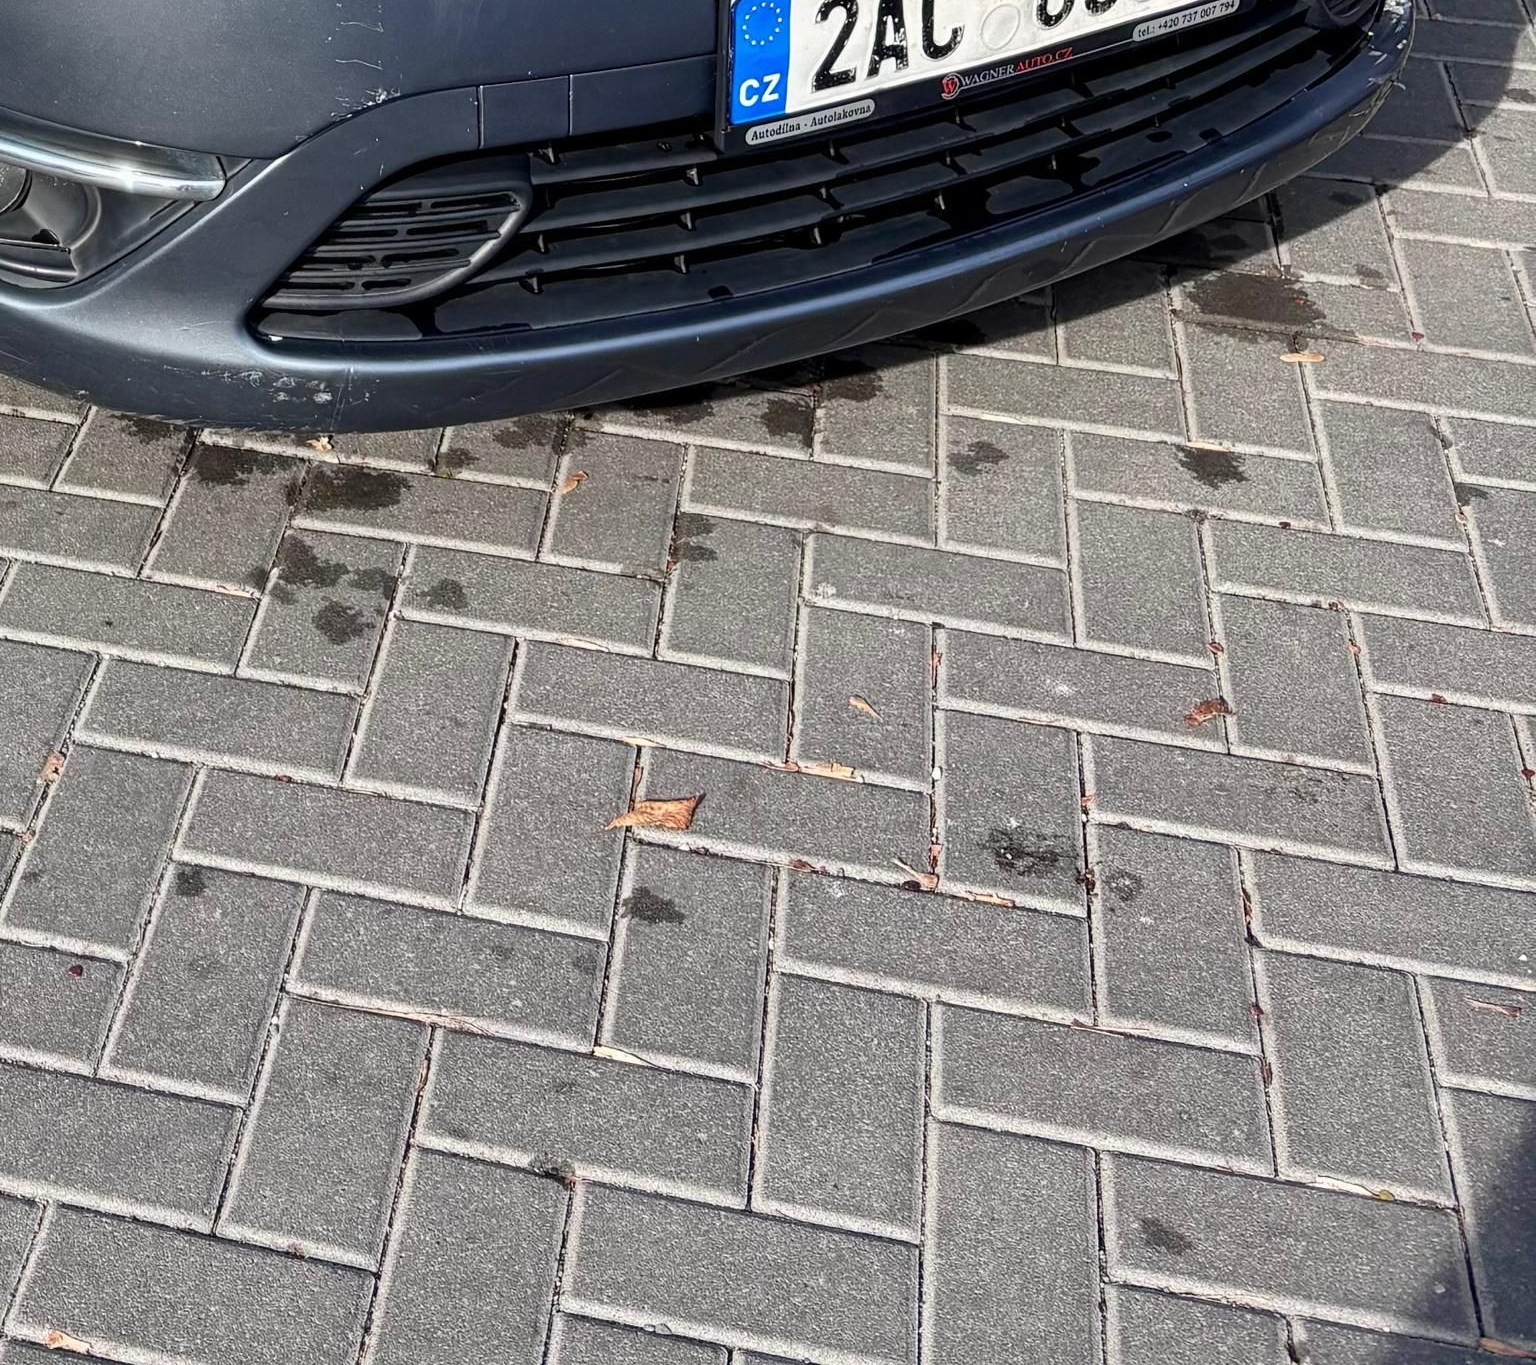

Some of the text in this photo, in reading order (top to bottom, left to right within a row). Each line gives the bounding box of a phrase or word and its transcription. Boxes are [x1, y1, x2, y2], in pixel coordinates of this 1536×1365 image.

[1182, 11, 1198, 25] 737
[1200, 5, 1216, 19] 007
[1219, 0, 1235, 13] 794
[739, 73, 780, 107] CZ
[751, 122, 801, 141] Autodílna
[810, 104, 872, 128] Autolakovna
